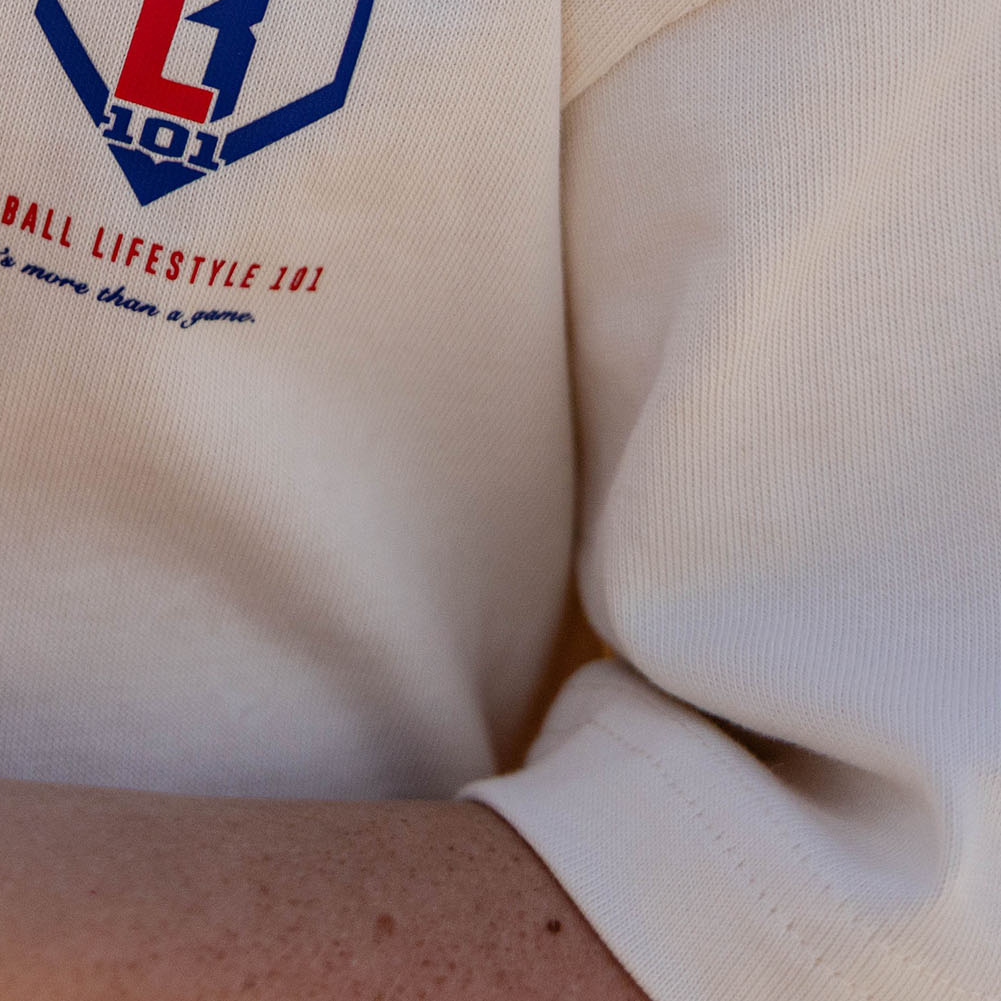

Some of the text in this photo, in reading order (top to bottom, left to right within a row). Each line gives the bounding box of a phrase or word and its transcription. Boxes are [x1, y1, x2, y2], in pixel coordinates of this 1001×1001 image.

[103, 105, 219, 172] 101
[92, 227, 261, 288] LIFESTYLE
[270, 266, 324, 291] 101
[21, 263, 89, 294] more
[96, 286, 158, 317] than
[166, 309, 183, 321] a
[180, 308, 255, 329] game.
